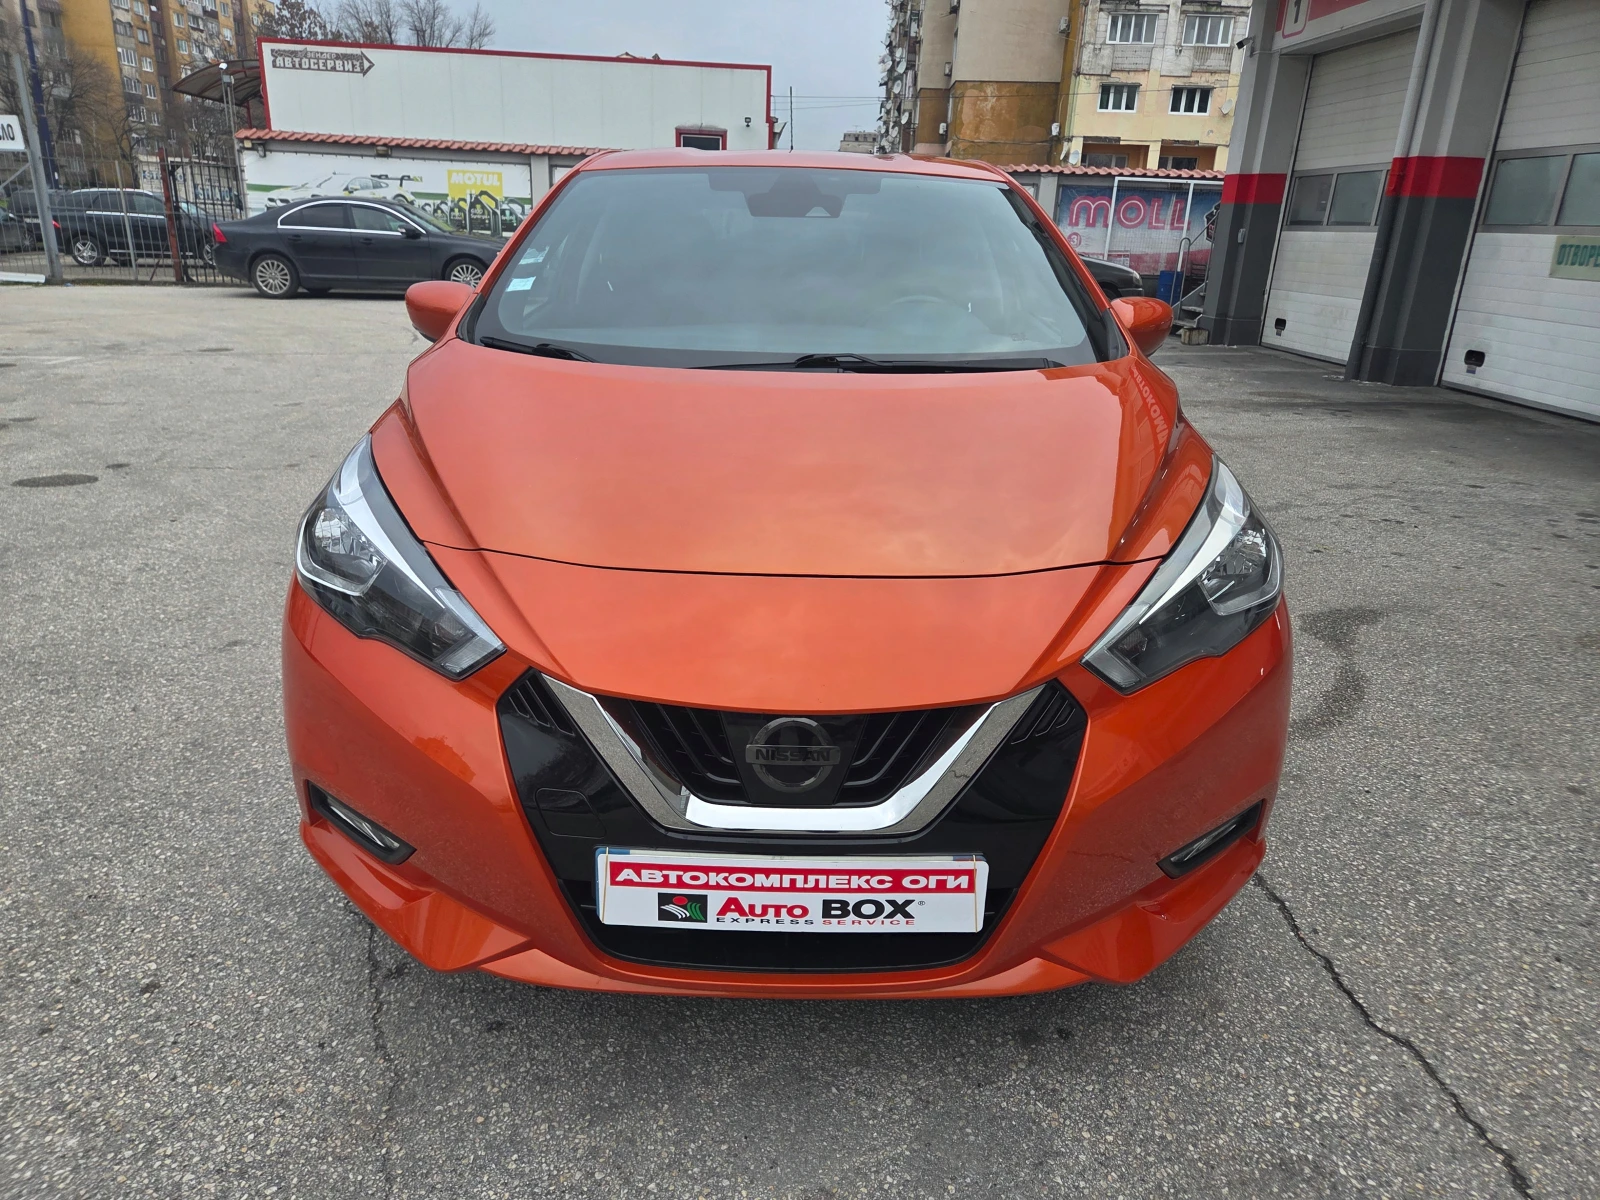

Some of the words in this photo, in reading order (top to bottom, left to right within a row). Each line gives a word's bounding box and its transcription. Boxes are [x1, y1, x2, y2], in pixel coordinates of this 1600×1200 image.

[275, 57, 362, 72] АВТОСЕРВИЗ
[0, 123, 15, 141] ЛО
[451, 173, 499, 185] MOTUL
[1068, 195, 1191, 231] MOLL
[755, 748, 831, 762] NISSAN
[615, 868, 893, 889] АВТОКОМПЛЕКС
[902, 875, 969, 889] ОГИ
[716, 917, 814, 926] EXPRESS
